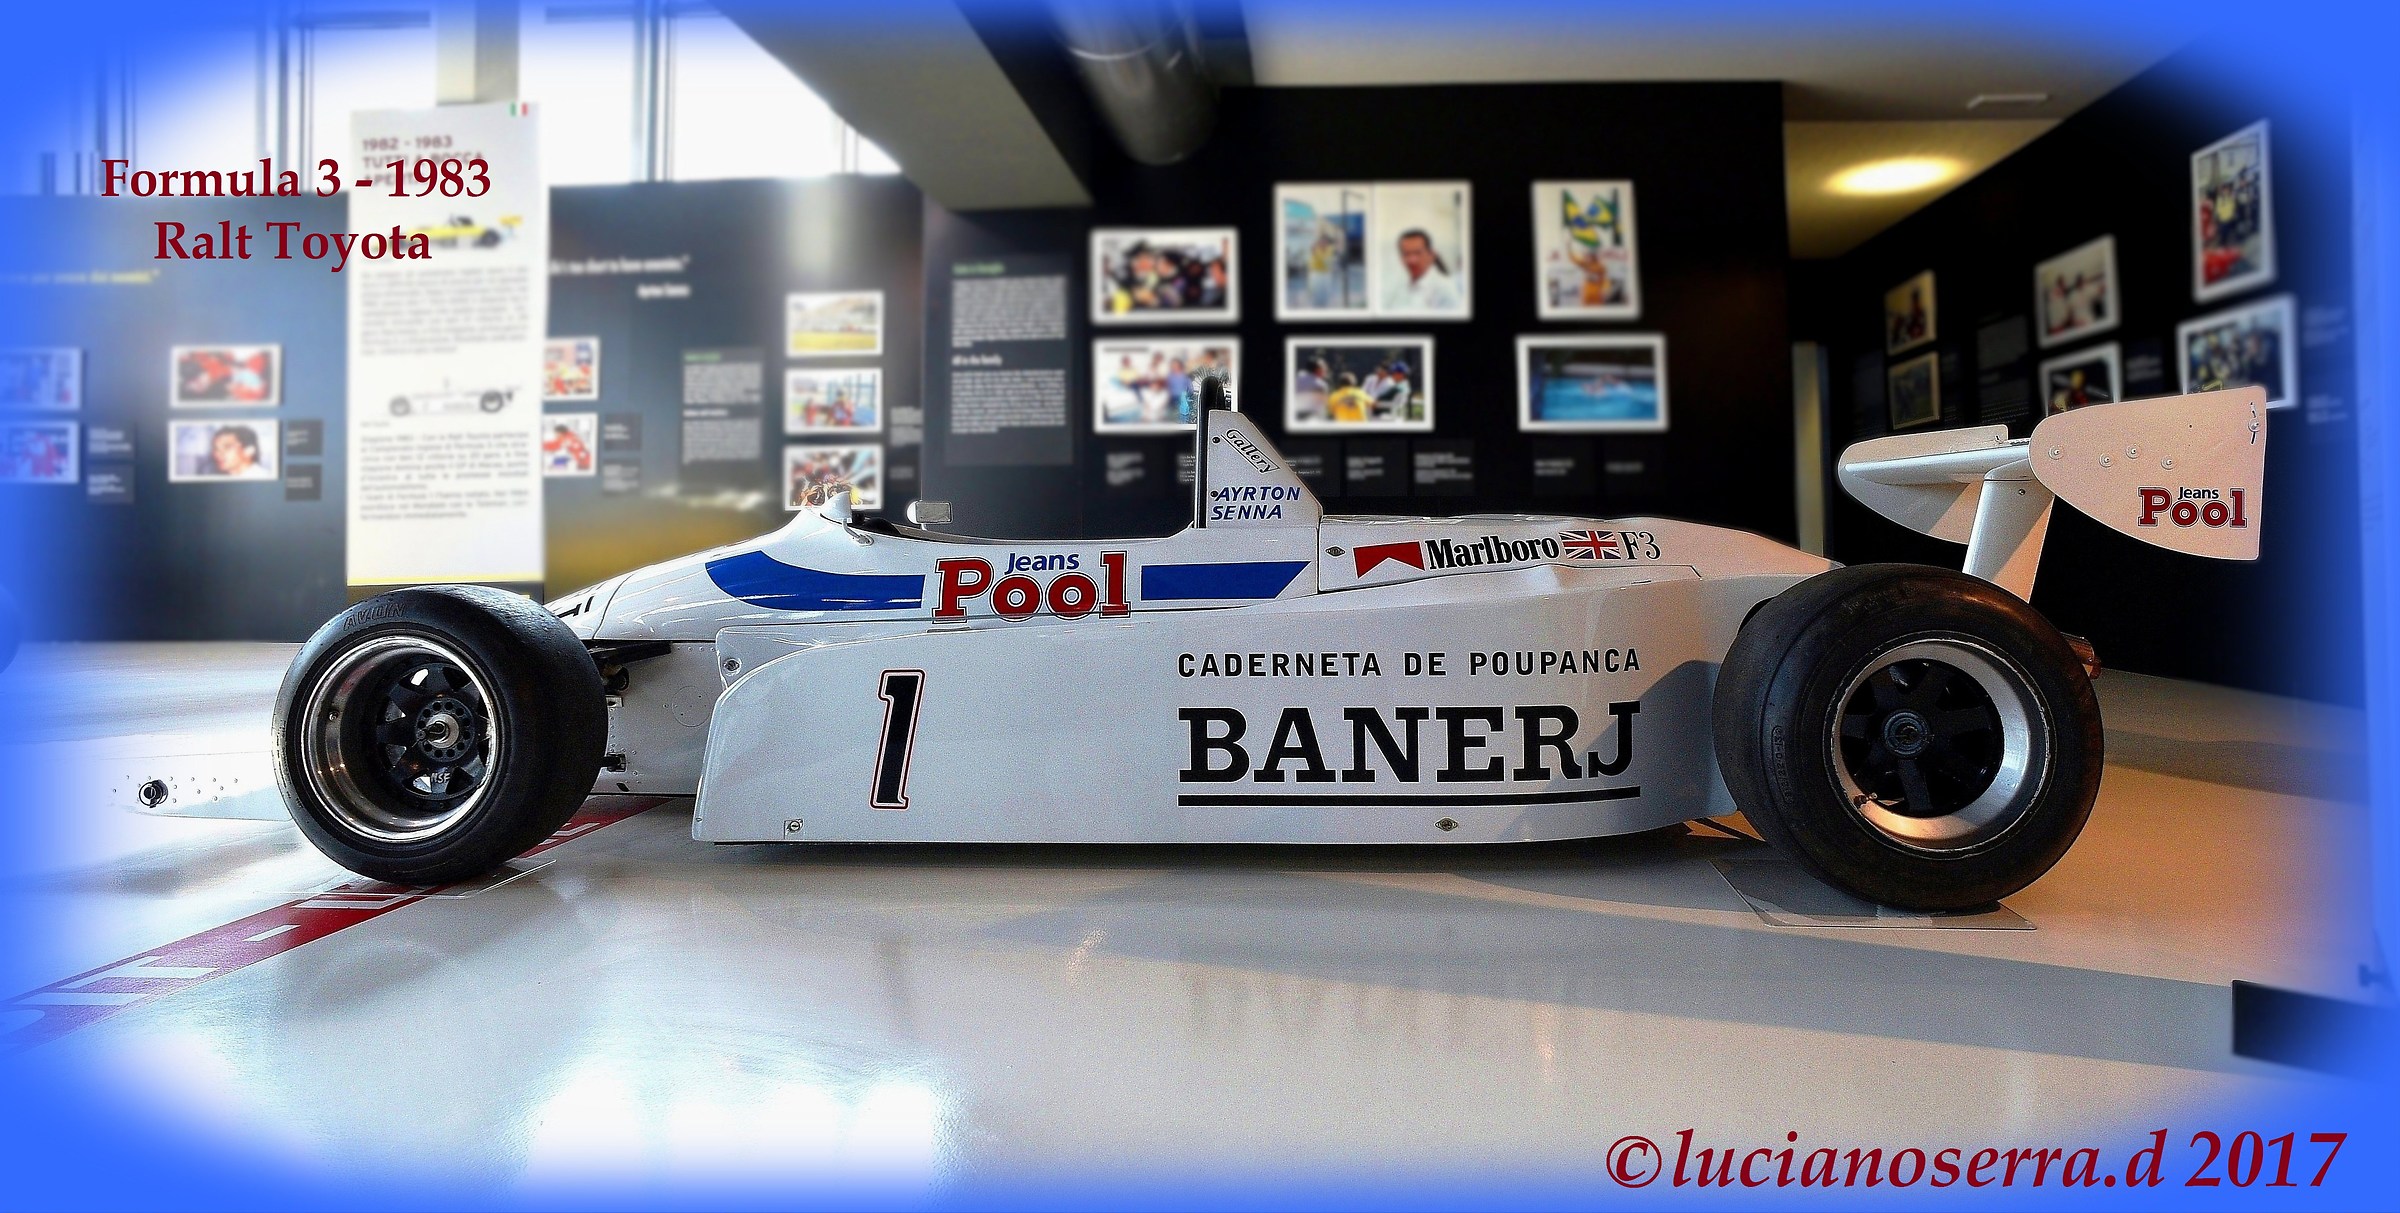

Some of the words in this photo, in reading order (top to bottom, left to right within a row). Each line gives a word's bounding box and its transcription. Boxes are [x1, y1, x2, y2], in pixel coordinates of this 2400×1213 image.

[1226, 429, 1272, 474] Gallery
[1211, 504, 1282, 520] SENNA
[1214, 486, 1301, 502] AYRTON
[2137, 487, 2248, 528] Pool
[2178, 487, 2219, 500] Jeans
[1004, 552, 1080, 575] Jeans
[1424, 535, 1560, 570] Marlboro
[1617, 531, 1662, 561] F3
[932, 550, 1132, 624] Pool
[1178, 651, 1382, 677] CADERNETA
[1403, 652, 1447, 676] DE
[1470, 648, 1641, 676] POUPANCA
[869, 668, 927, 811] 1
[1178, 701, 1641, 783] BANERJ
